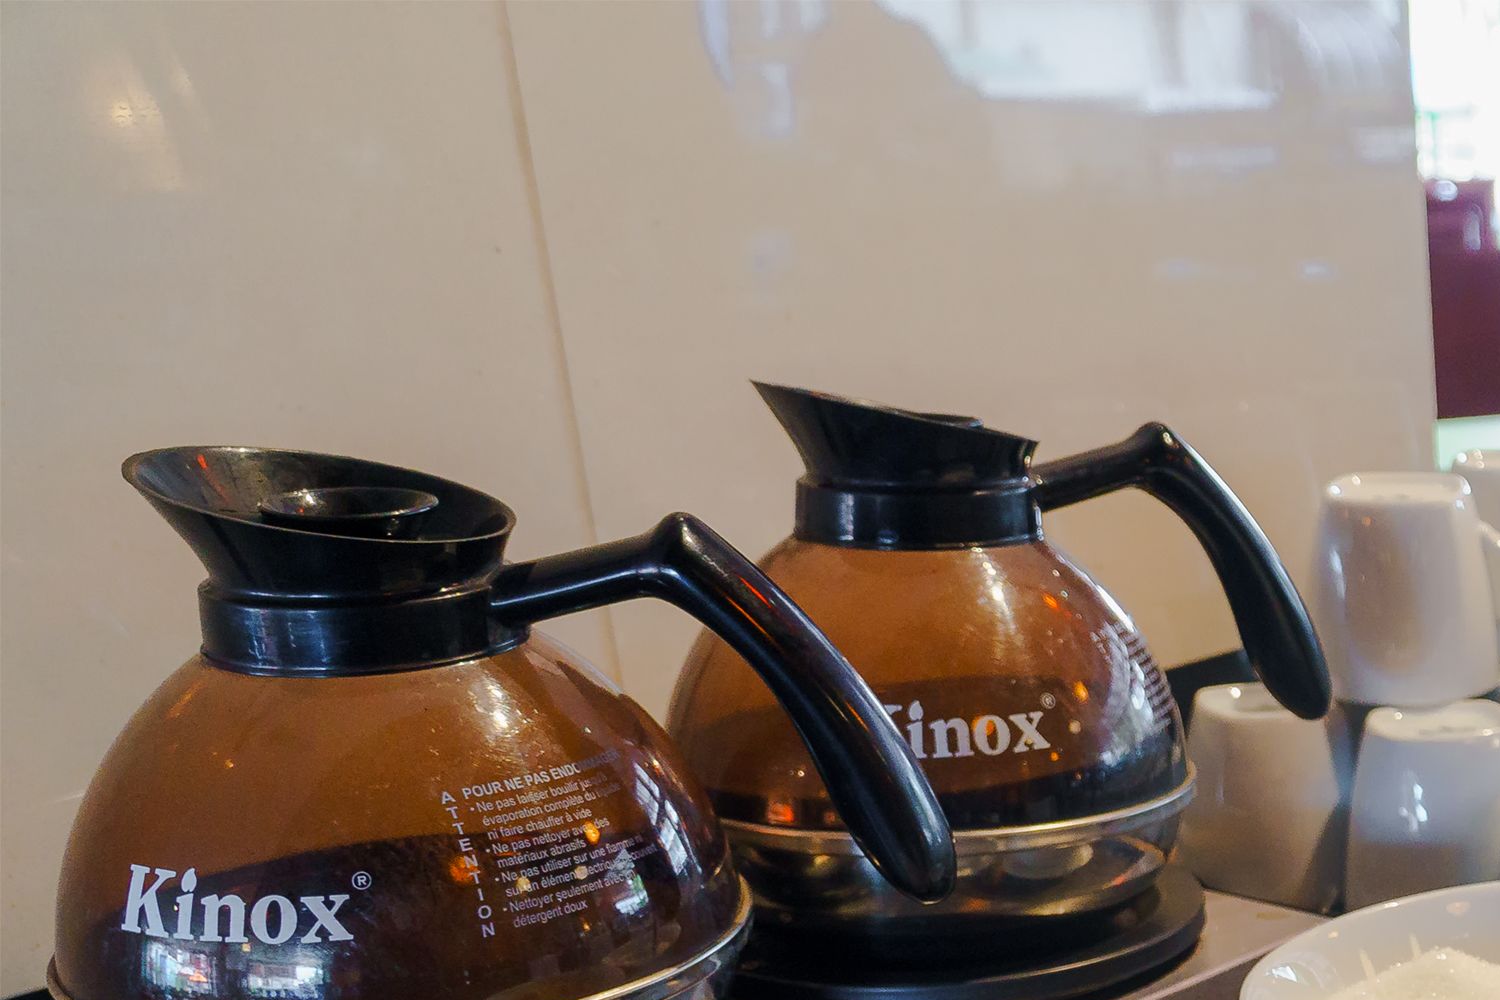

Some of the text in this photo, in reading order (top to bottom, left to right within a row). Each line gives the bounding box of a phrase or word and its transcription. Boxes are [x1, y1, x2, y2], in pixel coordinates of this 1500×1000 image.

[462, 781, 504, 799] POUR
[504, 777, 525, 790] NE
[524, 771, 550, 787] PAS
[476, 799, 496, 813] Ne
[497, 799, 516, 813] pas
[518, 790, 549, 805] laisser
[550, 781, 579, 797] bouillir
[482, 804, 542, 827] évaporation
[544, 794, 584, 813] complète
[584, 791, 596, 802] du
[487, 807, 592, 841] ni faire chauffer à vide
[492, 818, 610, 855] Ne pas nettoyer ave des
[497, 838, 587, 869] matériaux abrasifs
[441, 791, 495, 938] ATTENTION
[502, 869, 518, 883] Ne
[521, 866, 539, 881] pas
[541, 857, 571, 873] utiliser
[574, 852, 589, 864] sur
[589, 847, 606, 859] une
[541, 869, 580, 888] élémen
[582, 857, 618, 875] lectriq
[509, 892, 554, 914] Nettoyer
[556, 880, 603, 902] seulement
[513, 899, 588, 929] détergent doux
